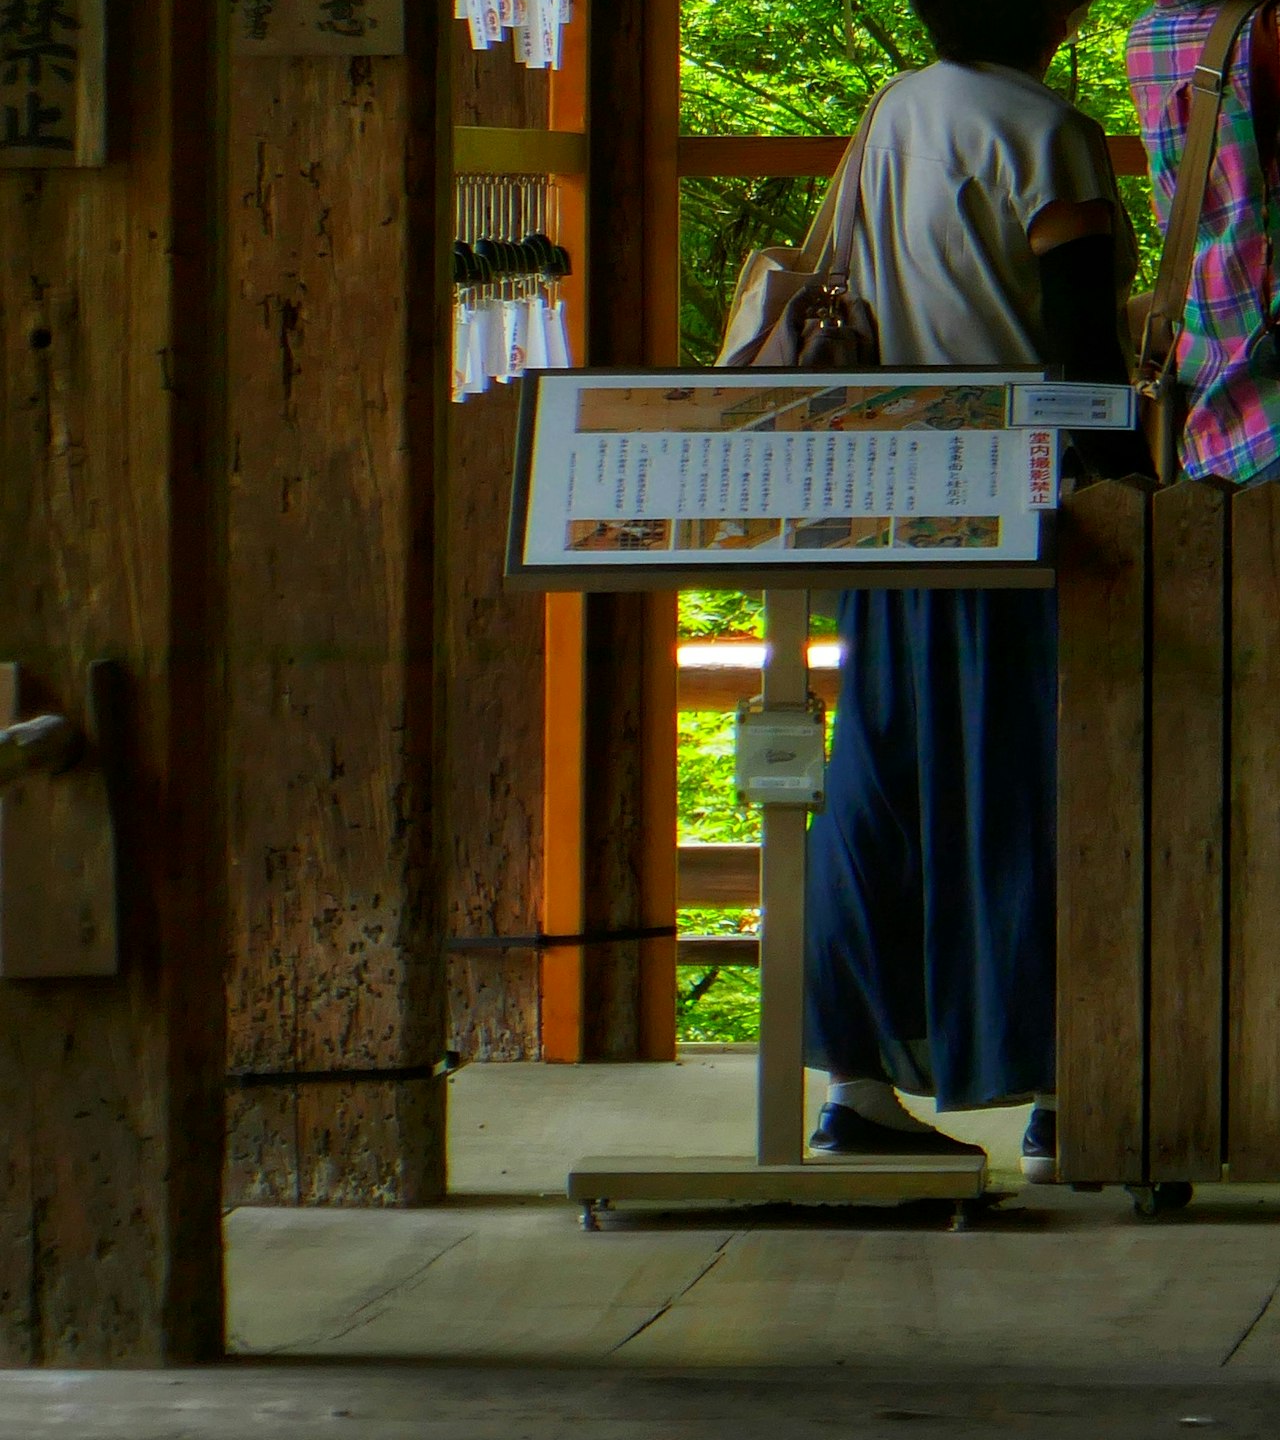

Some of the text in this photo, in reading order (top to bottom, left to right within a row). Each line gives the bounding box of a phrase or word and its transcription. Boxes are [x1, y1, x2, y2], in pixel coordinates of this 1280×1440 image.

[1028, 431, 1051, 505] 堂内撮影禁止
